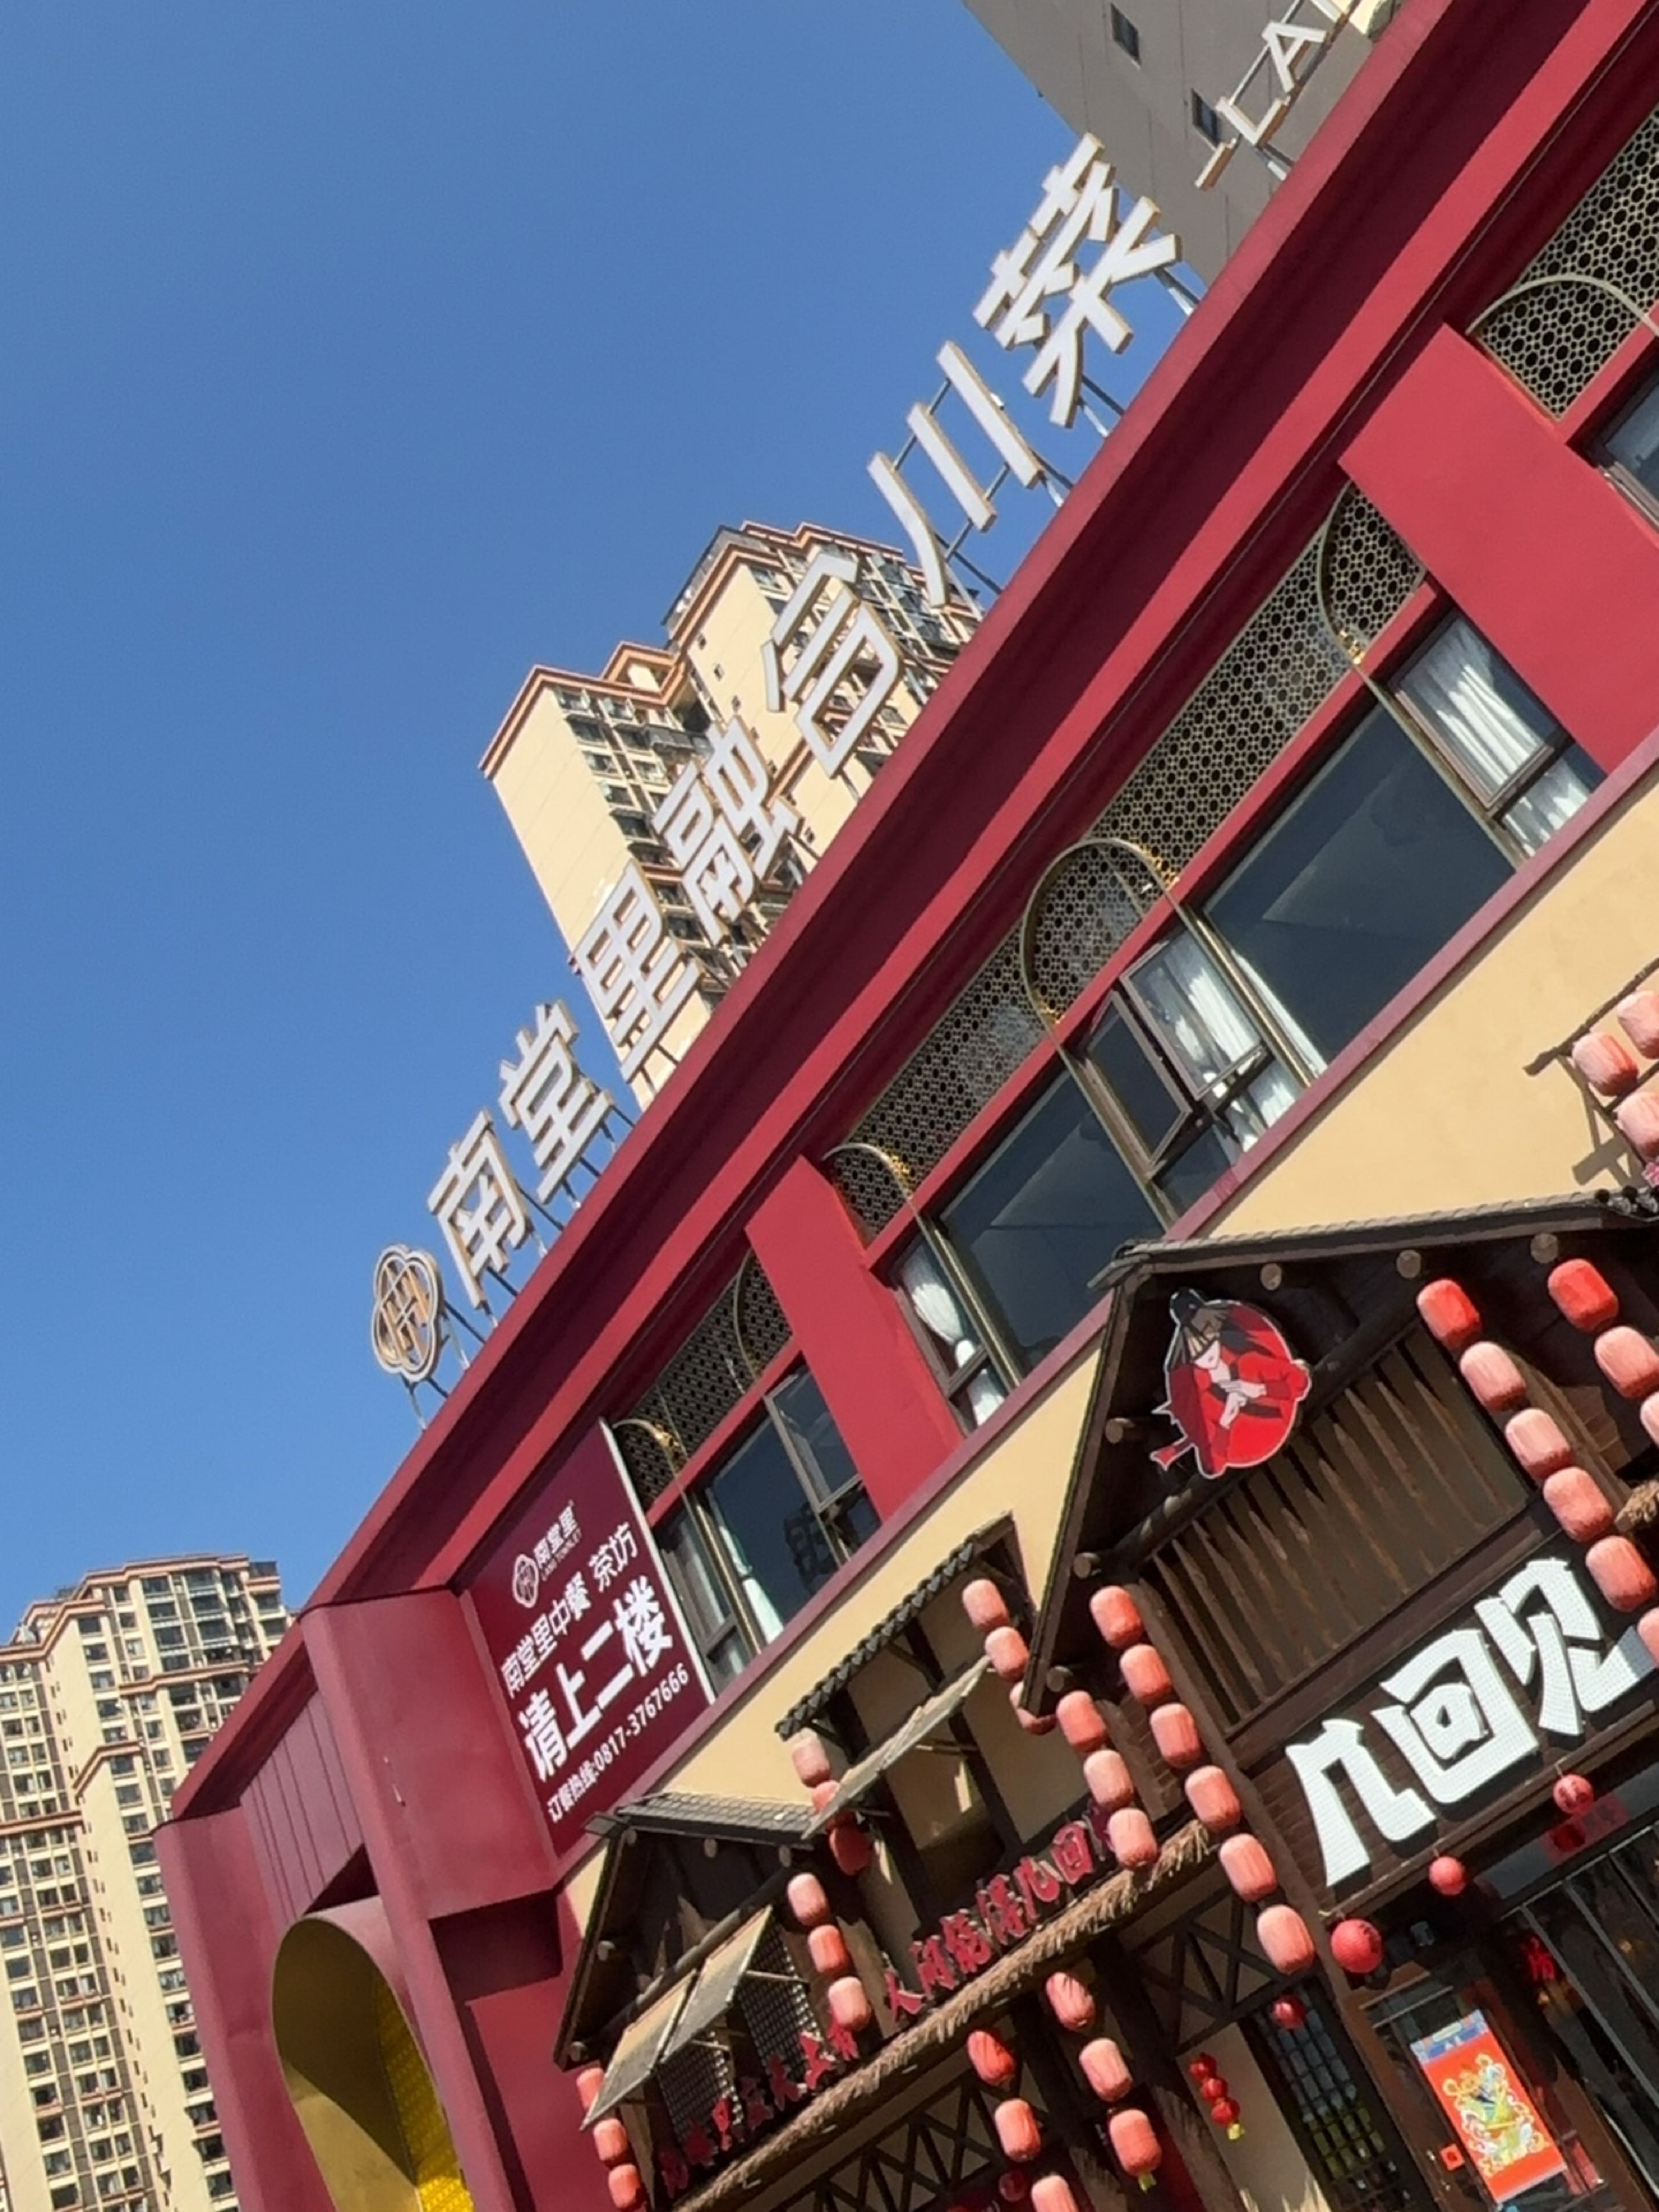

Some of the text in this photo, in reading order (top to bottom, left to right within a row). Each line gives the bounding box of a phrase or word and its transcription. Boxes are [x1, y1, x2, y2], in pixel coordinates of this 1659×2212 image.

[501, 1522, 639, 1699] 南堂里中餐 茶坊
[518, 1575, 673, 1783] 请上二楼
